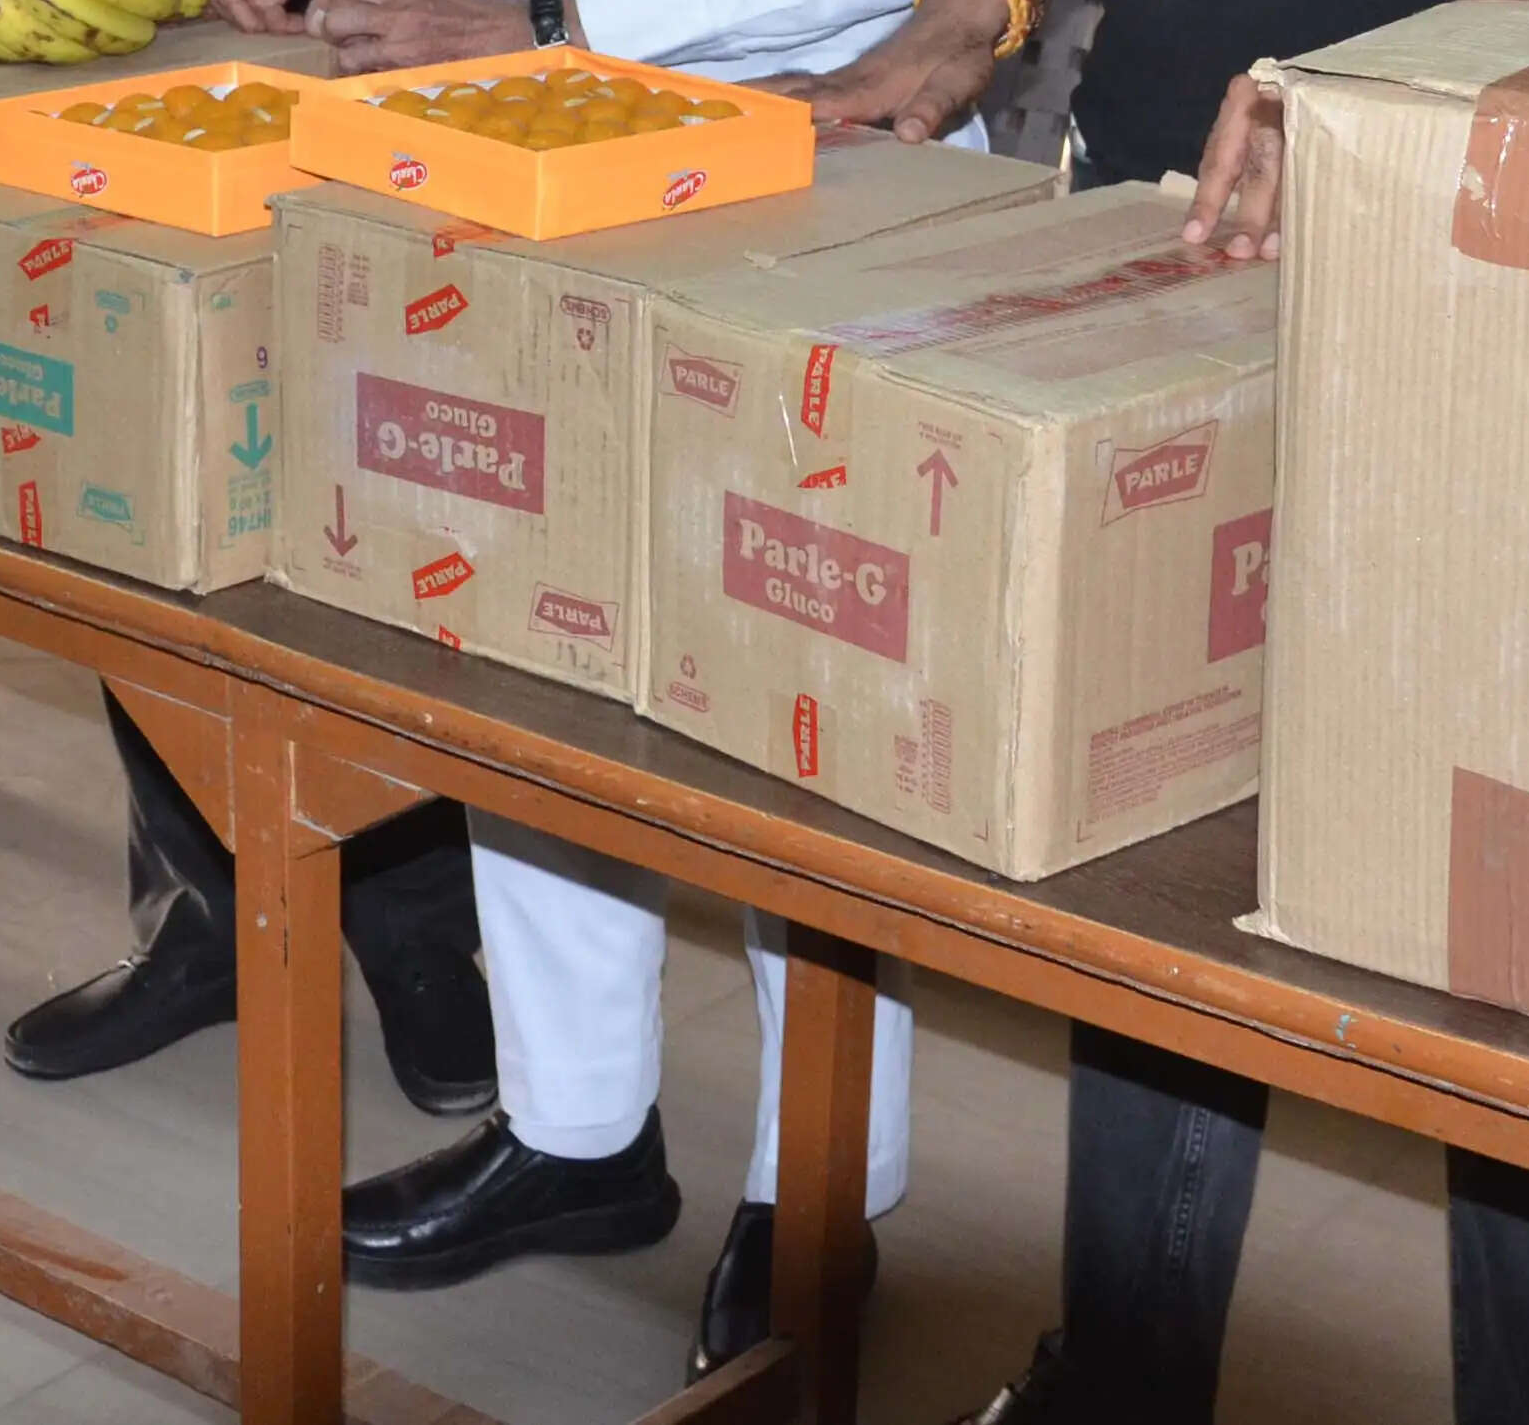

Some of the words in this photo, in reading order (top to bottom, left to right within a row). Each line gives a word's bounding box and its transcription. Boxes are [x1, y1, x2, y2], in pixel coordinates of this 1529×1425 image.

[24, 239, 73, 272] PARLE
[409, 292, 461, 331] PARLE
[676, 366, 730, 396] PARLE
[807, 346, 830, 426] PARLE
[425, 401, 498, 438] Gluco
[377, 421, 527, 491] Parle-G
[1124, 453, 1200, 496] PARLE
[416, 561, 468, 596] PARLE
[738, 518, 888, 605] Parle-G
[542, 600, 604, 631] PARLE
[765, 577, 835, 624] Gluco
[799, 695, 812, 770] PARLE
